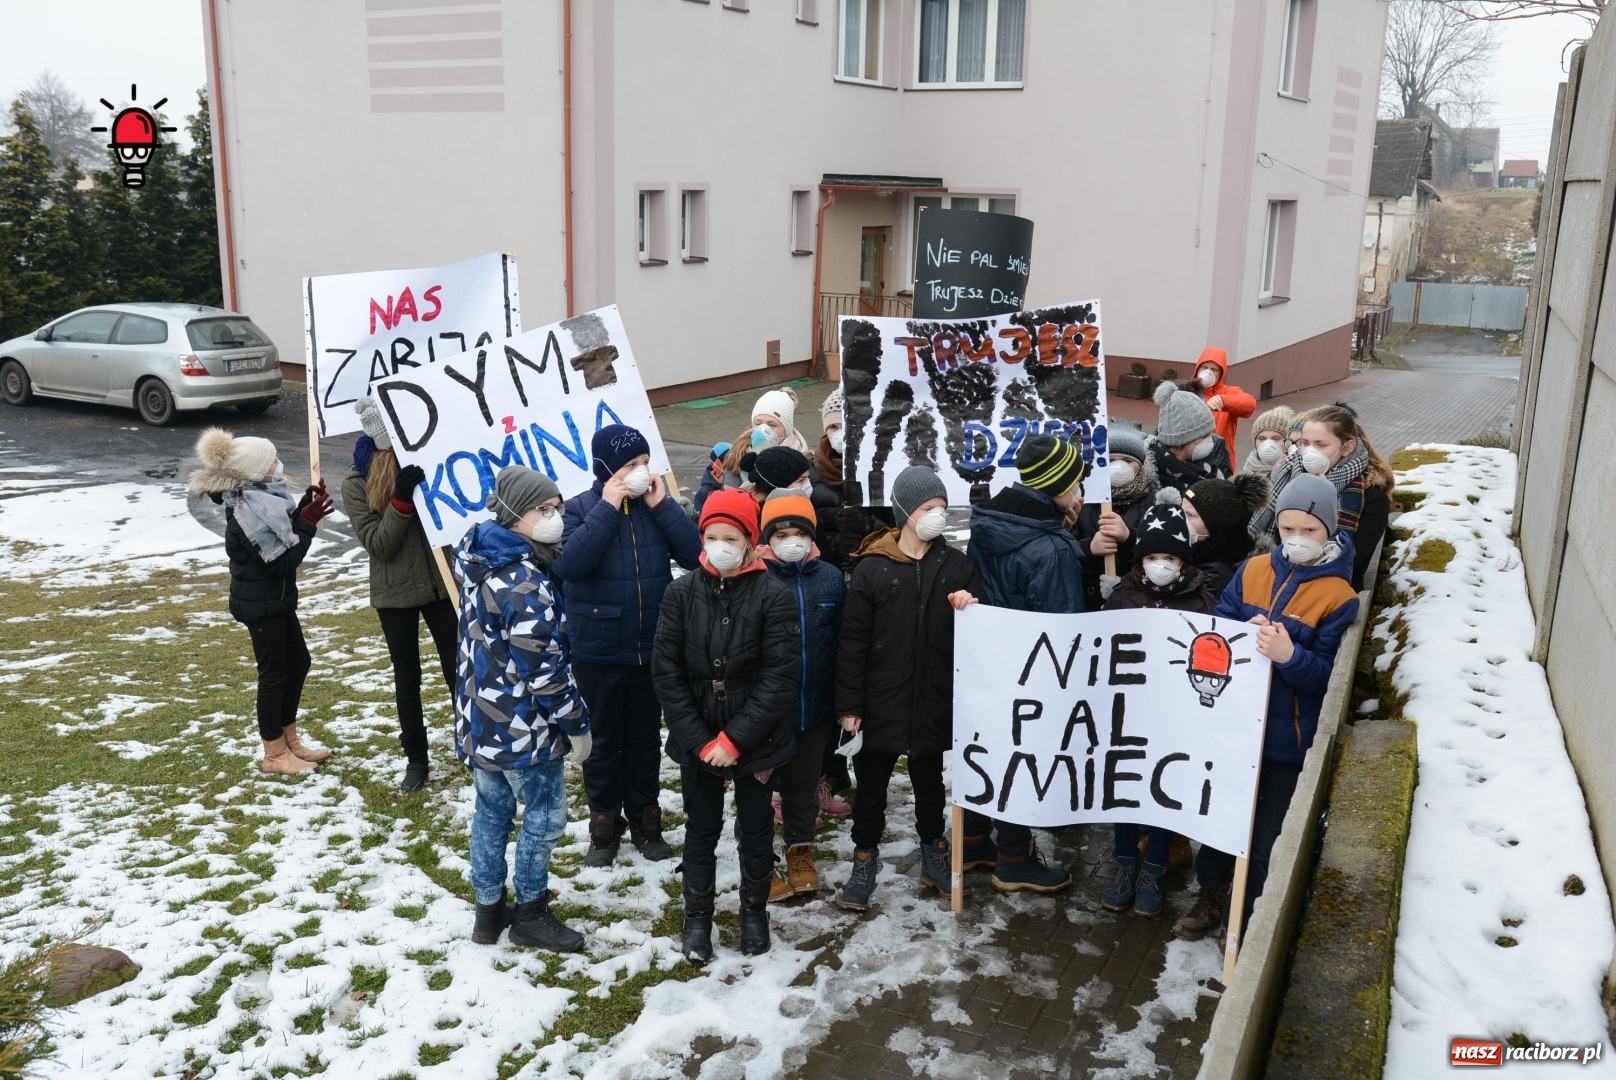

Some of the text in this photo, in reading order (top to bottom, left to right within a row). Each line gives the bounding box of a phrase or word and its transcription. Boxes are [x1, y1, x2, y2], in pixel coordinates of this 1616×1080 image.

[970, 250, 999, 268] PAL
[369, 284, 442, 335] NAS
[926, 279, 984, 312] TRUJESZ
[232, 361, 245, 370] SRC
[893, 323, 1100, 377] TRUJESZ
[377, 330, 570, 452] DYM
[1012, 692, 1149, 752] PAL
